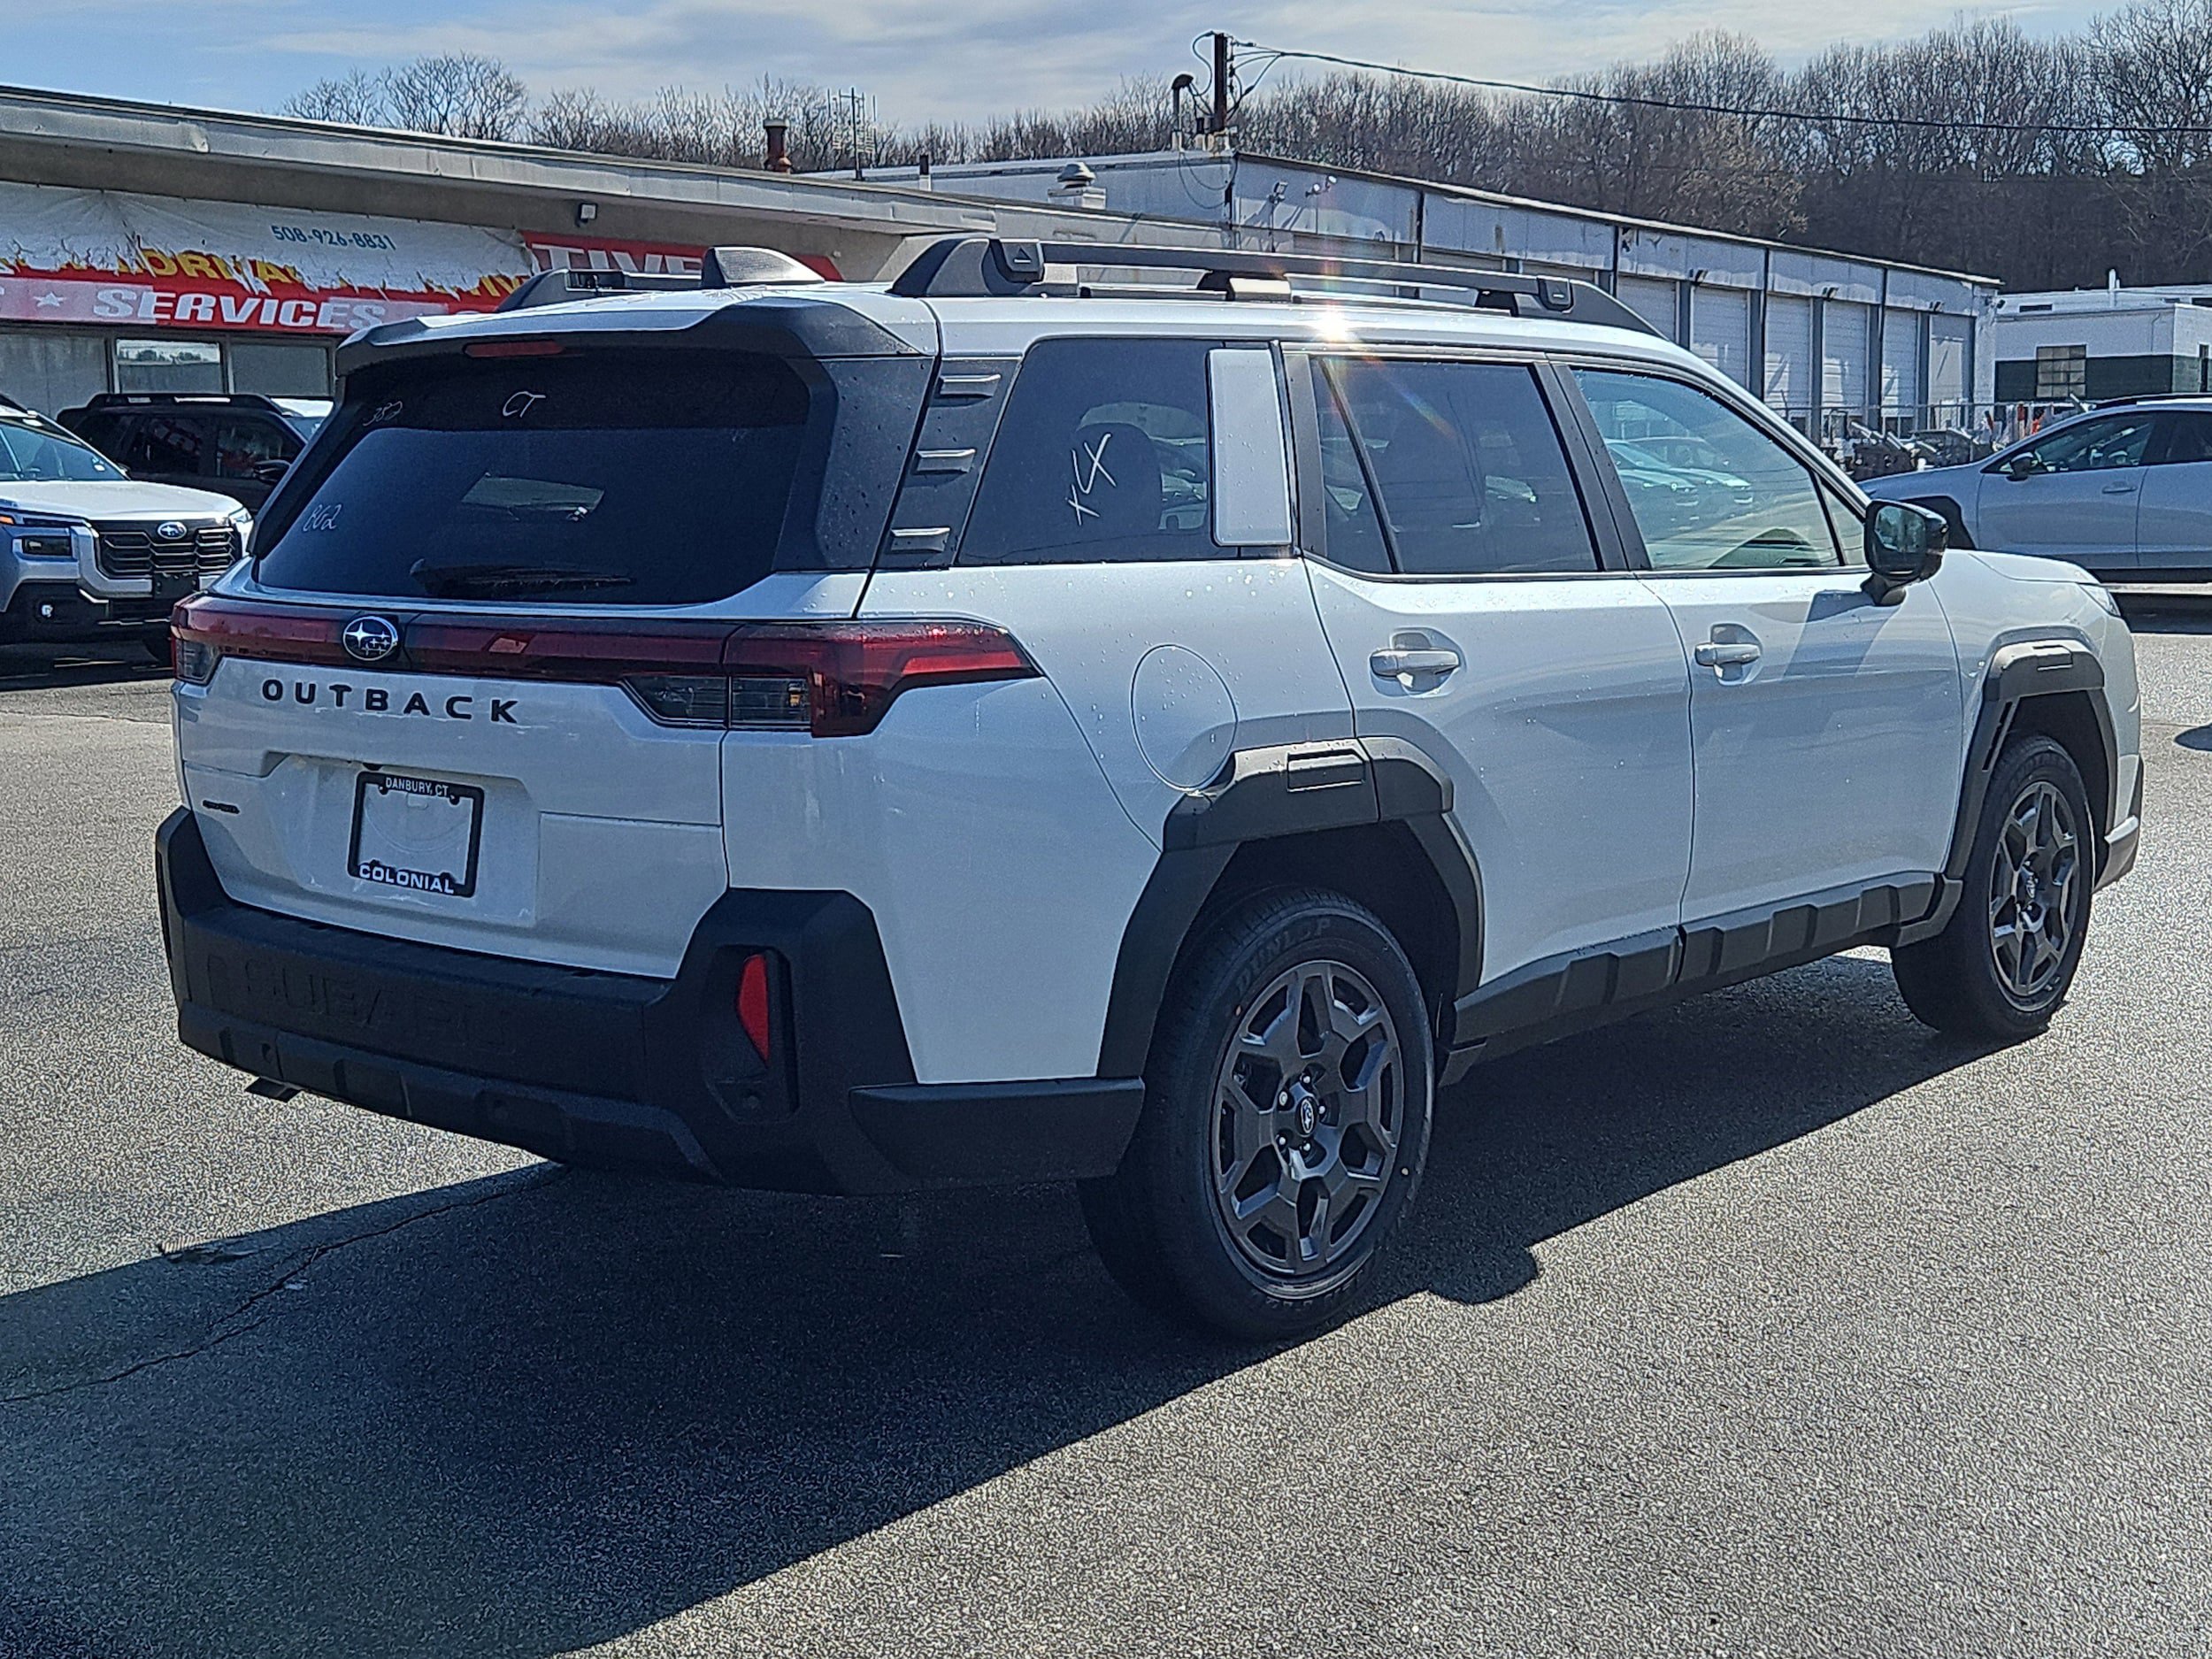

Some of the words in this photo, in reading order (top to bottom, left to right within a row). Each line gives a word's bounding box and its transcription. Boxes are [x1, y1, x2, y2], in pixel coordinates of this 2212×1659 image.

[270, 224, 397, 251] 508-926-8831
[93, 288, 386, 331] SERVICES
[262, 678, 519, 724] OUTBACK
[385, 776, 434, 795] DANBURY,
[434, 784, 449, 797] CT
[358, 864, 455, 895] COLONIAL
